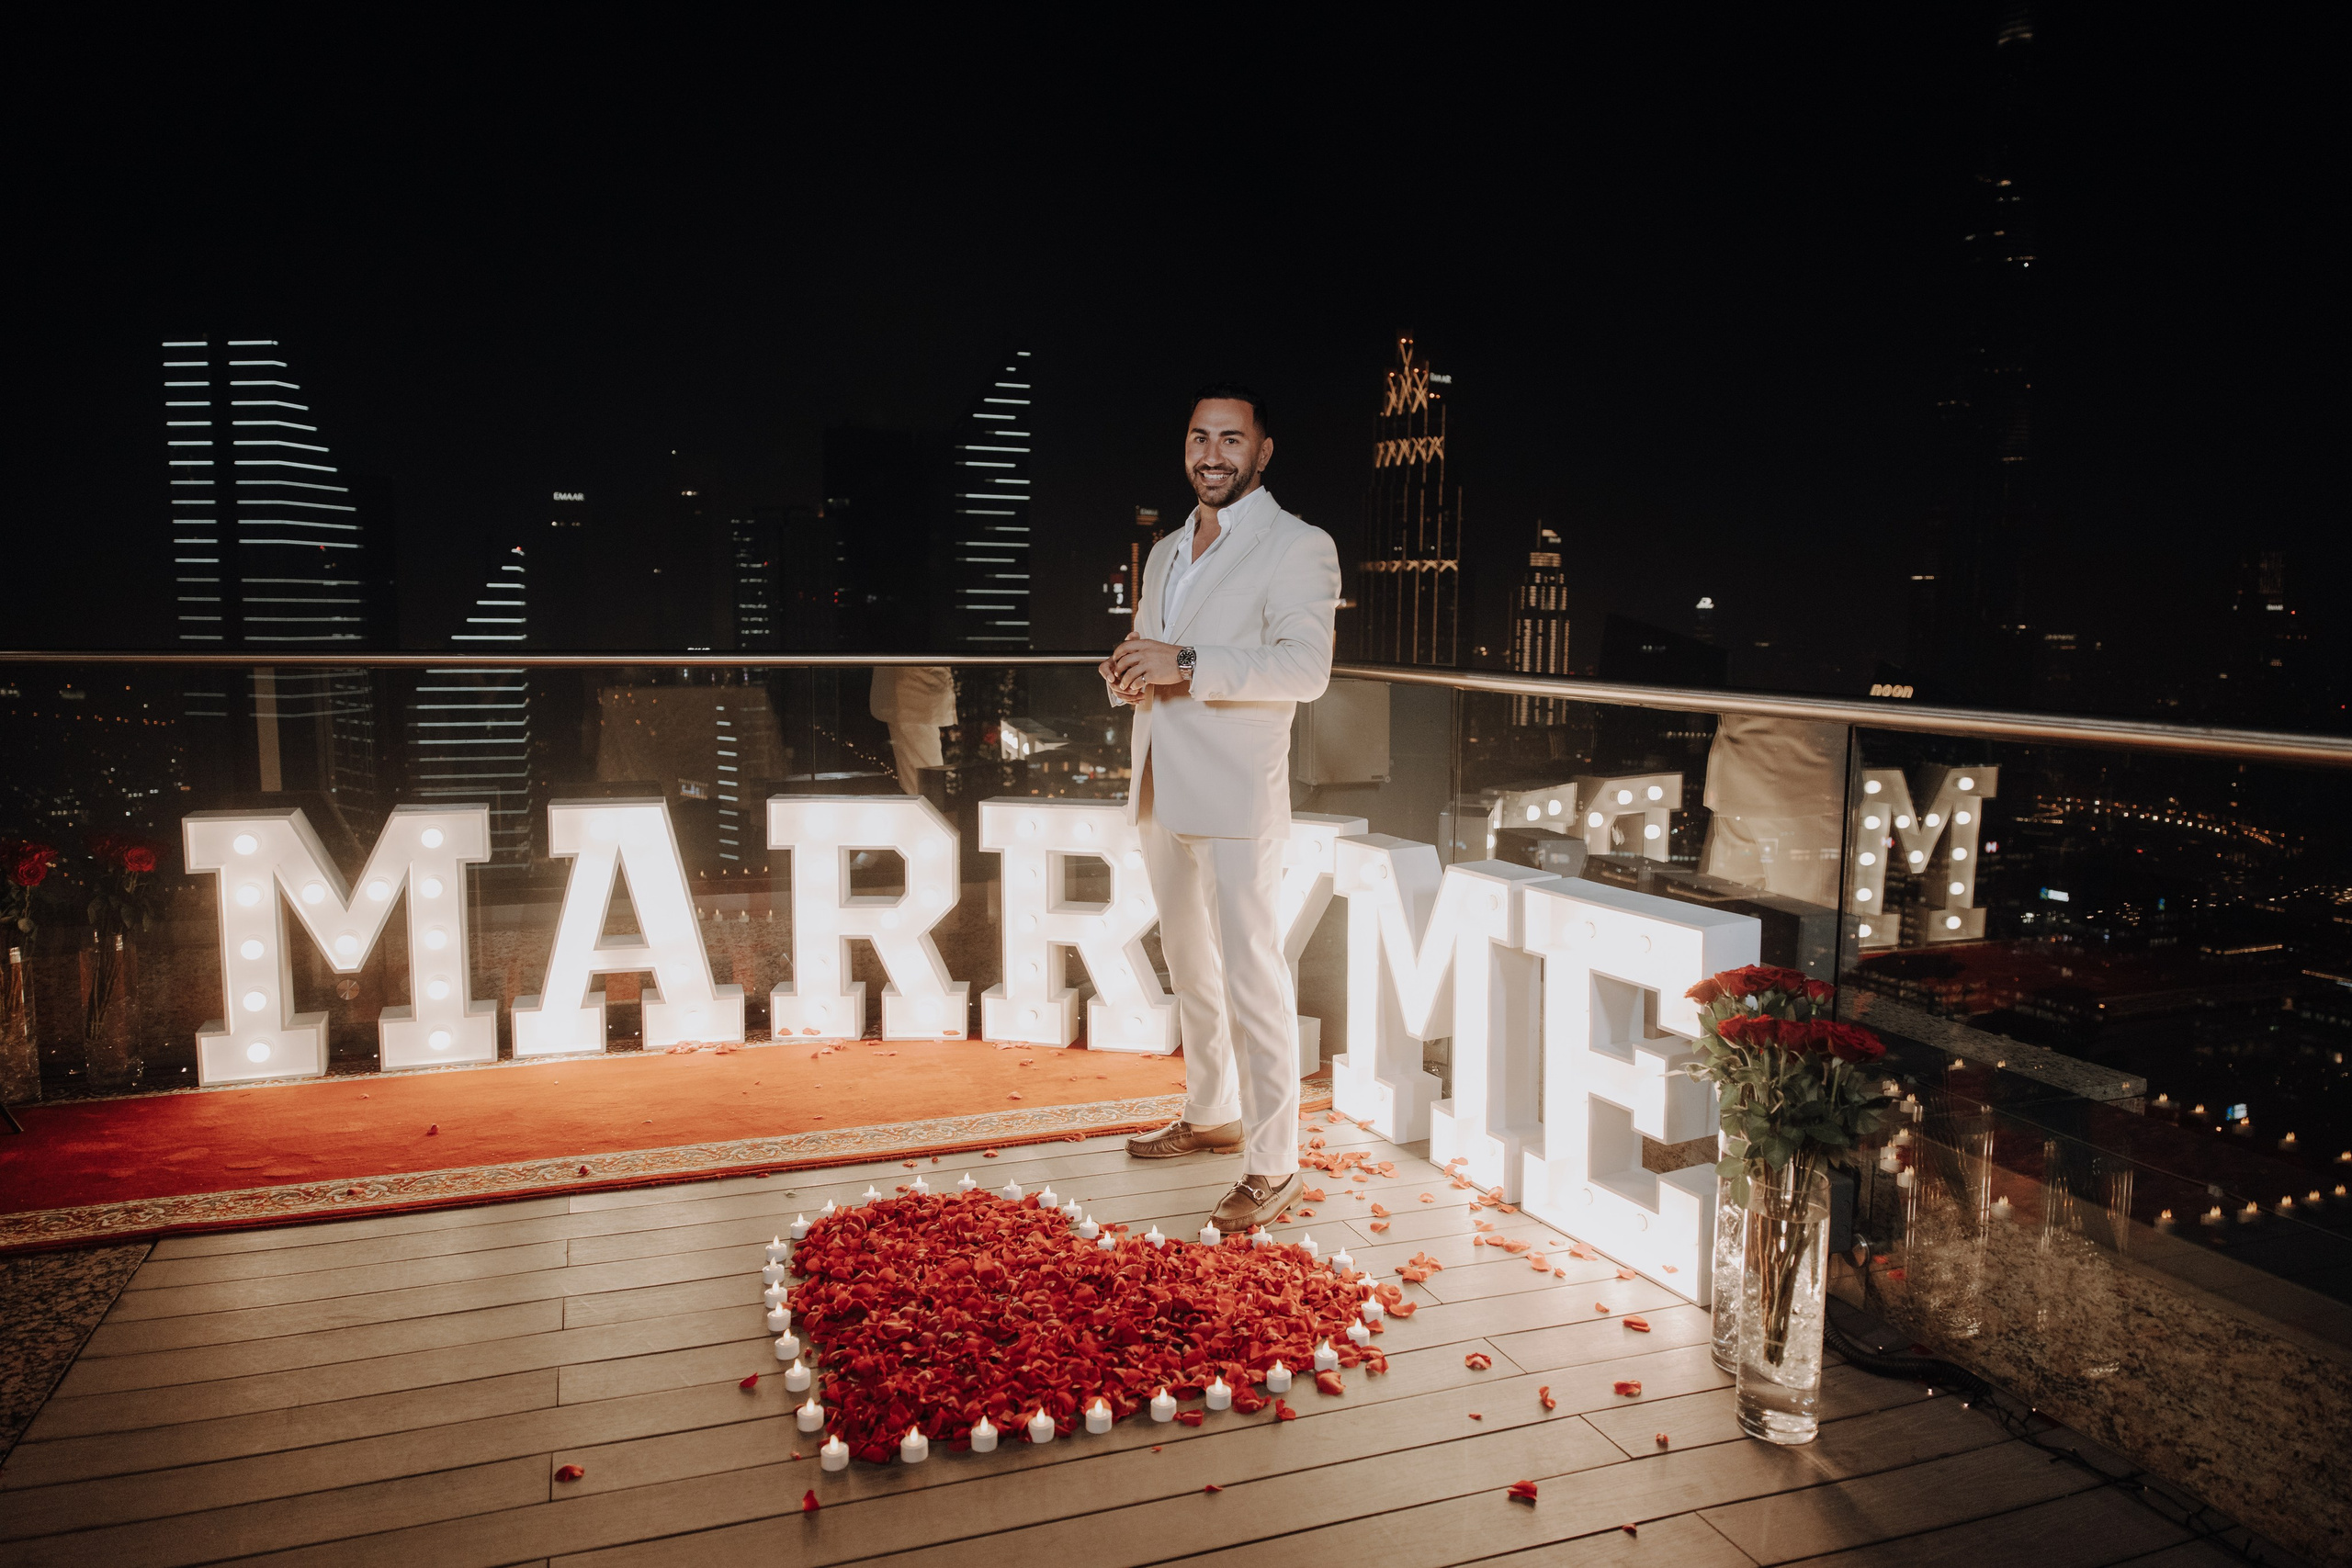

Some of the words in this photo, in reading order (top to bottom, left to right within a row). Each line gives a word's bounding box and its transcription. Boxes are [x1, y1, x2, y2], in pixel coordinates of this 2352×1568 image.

[553, 491, 585, 502] EMAAR
[1869, 683, 1914, 698] noon
[1332, 834, 1761, 1308] ME
